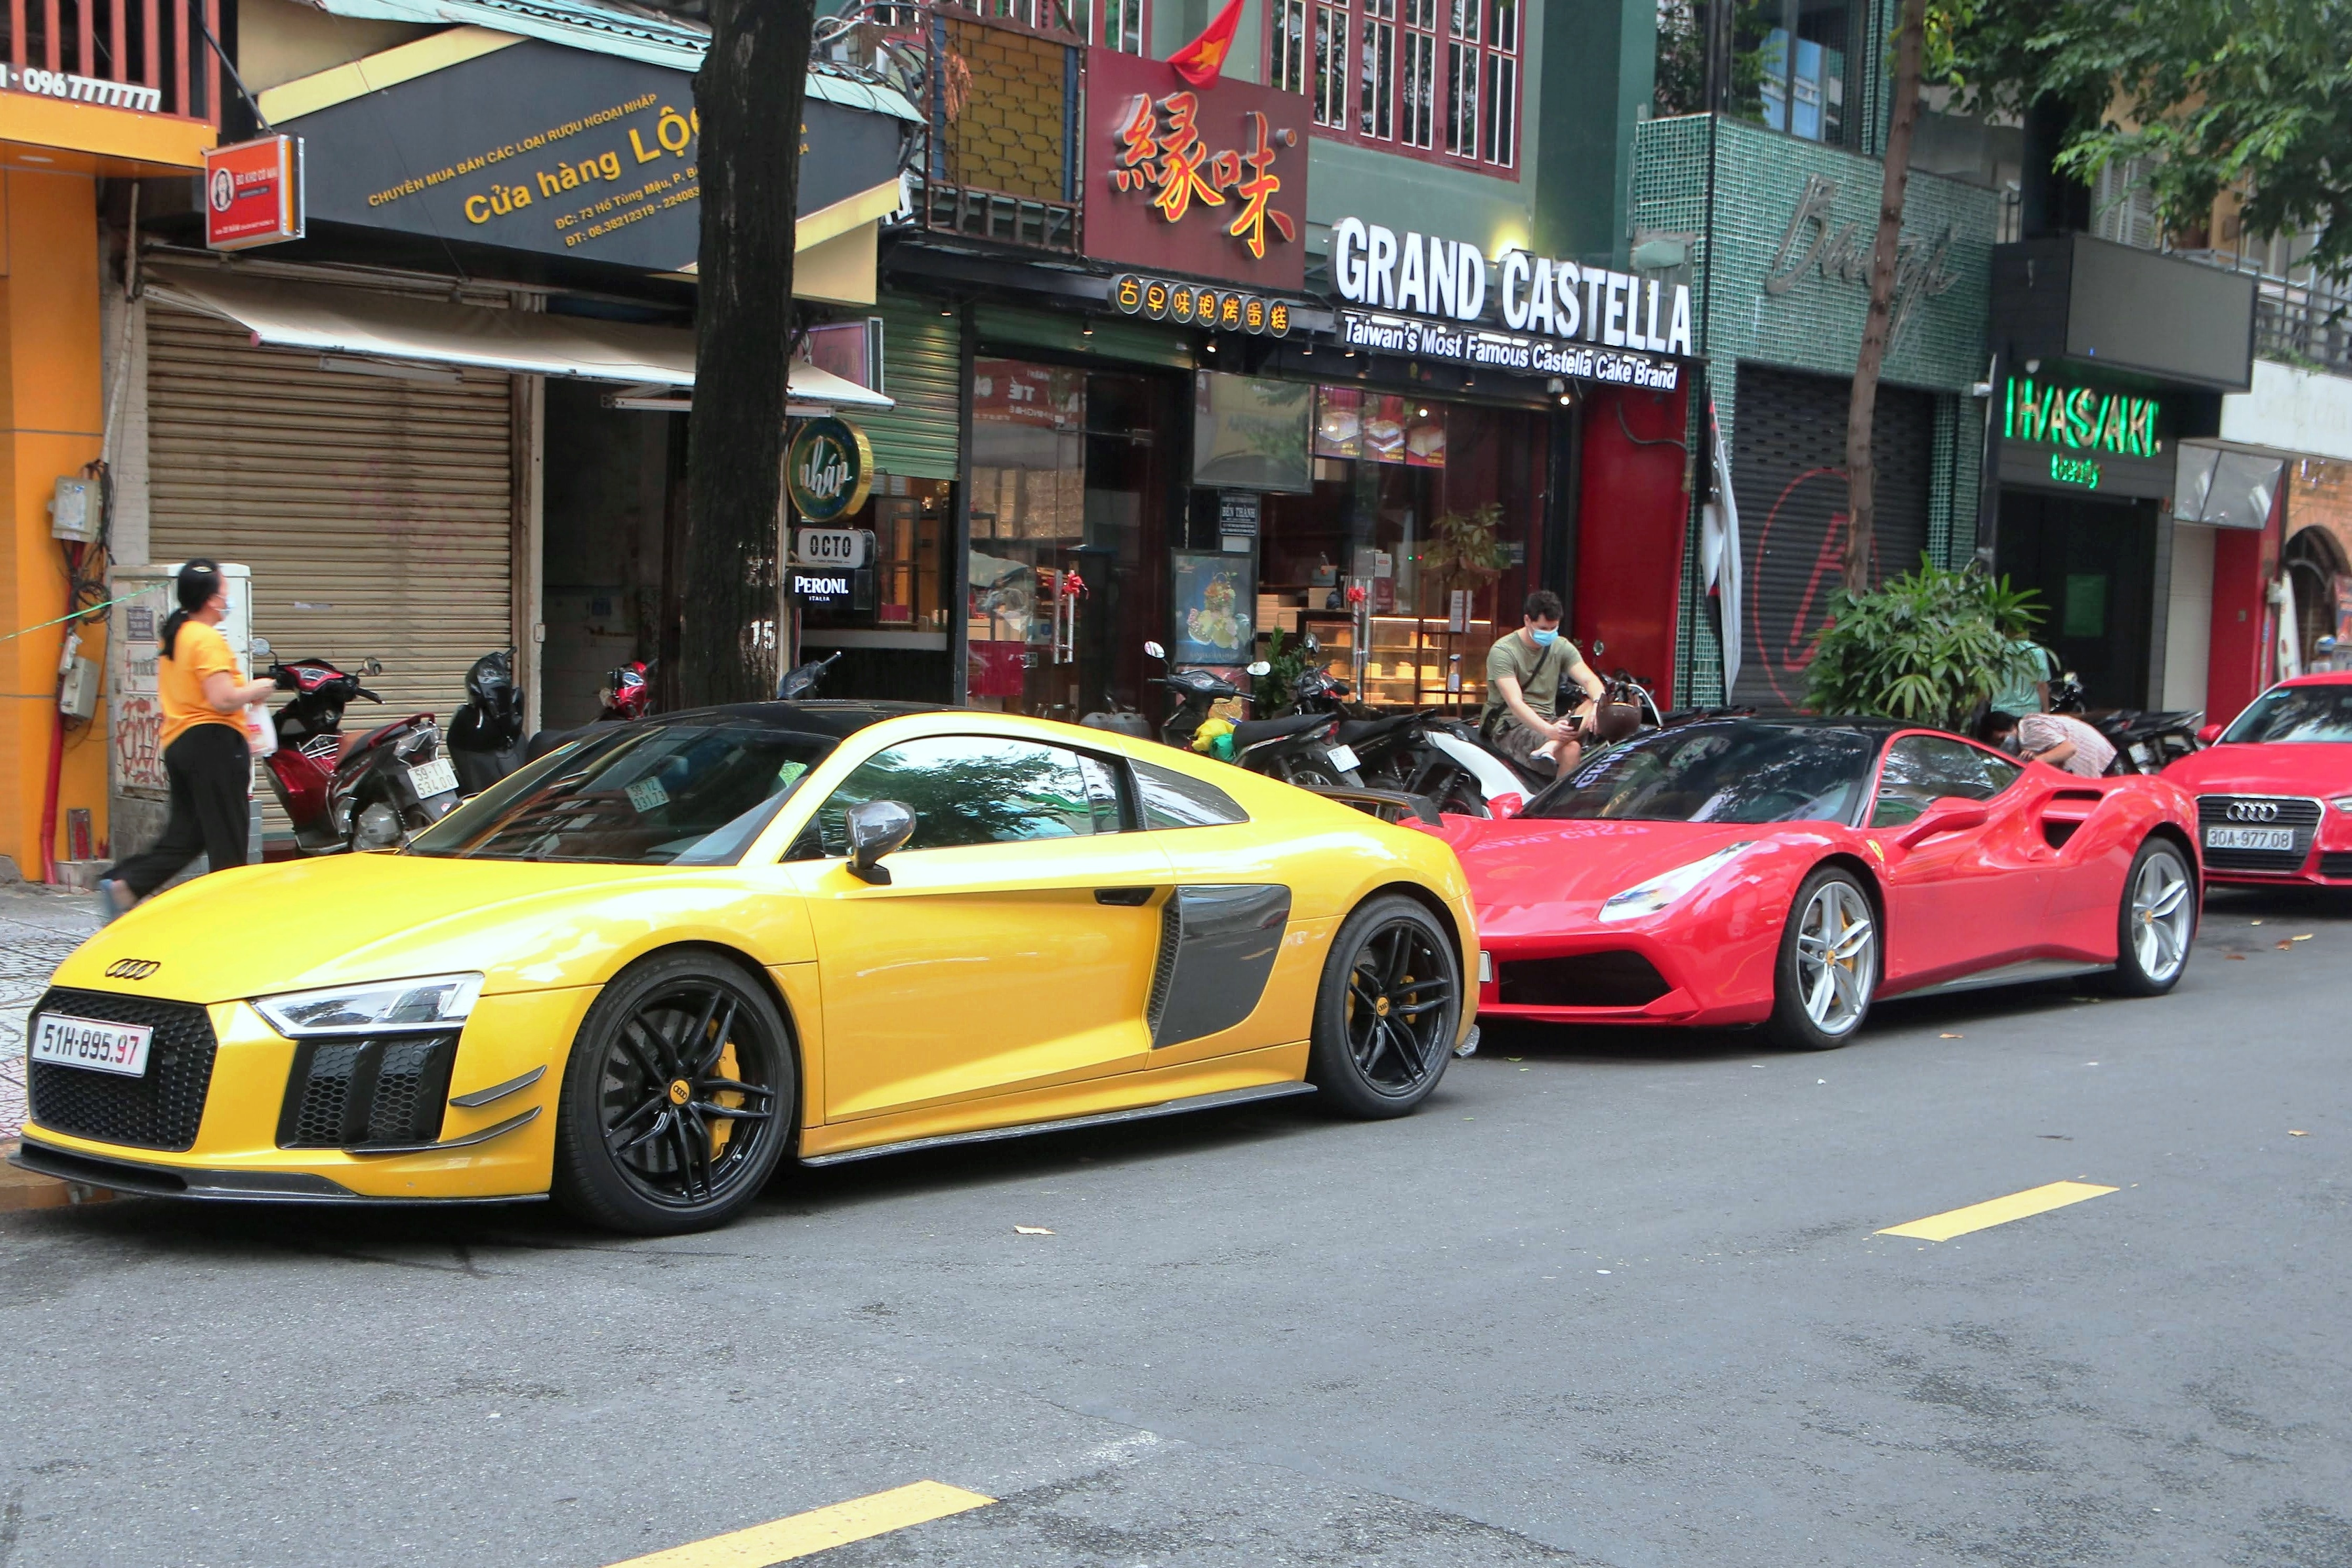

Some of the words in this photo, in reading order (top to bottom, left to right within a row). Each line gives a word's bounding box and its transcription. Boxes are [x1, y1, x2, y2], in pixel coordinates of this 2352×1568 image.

[369, 179, 425, 206] CHUYÊN
[426, 167, 456, 185] MUA
[456, 157, 486, 174] BÁN
[487, 147, 514, 163] CÁC
[516, 134, 546, 153] LOẠI
[547, 120, 583, 141] RƯỢU
[584, 106, 623, 128] NGOẠI
[623, 93, 657, 114] NHẬP
[465, 184, 532, 224] Cửa
[536, 151, 621, 198] hàng
[579, 207, 594, 220] 73
[612, 189, 644, 207] Tùng
[1336, 216, 1486, 321] GRAND
[1502, 251, 1692, 357] CASTELLA
[1344, 315, 1418, 353] Taiwan's
[1421, 326, 1463, 358] Most
[1466, 335, 1530, 368] Famous
[1532, 344, 1592, 377] Castella
[1596, 354, 1631, 383] Cake
[1634, 360, 1678, 390] Brand
[810, 534, 851, 558] OCTO
[2209, 830, 2290, 849] 30A-977.08
[43, 1024, 139, 1065] 51H-895.97
